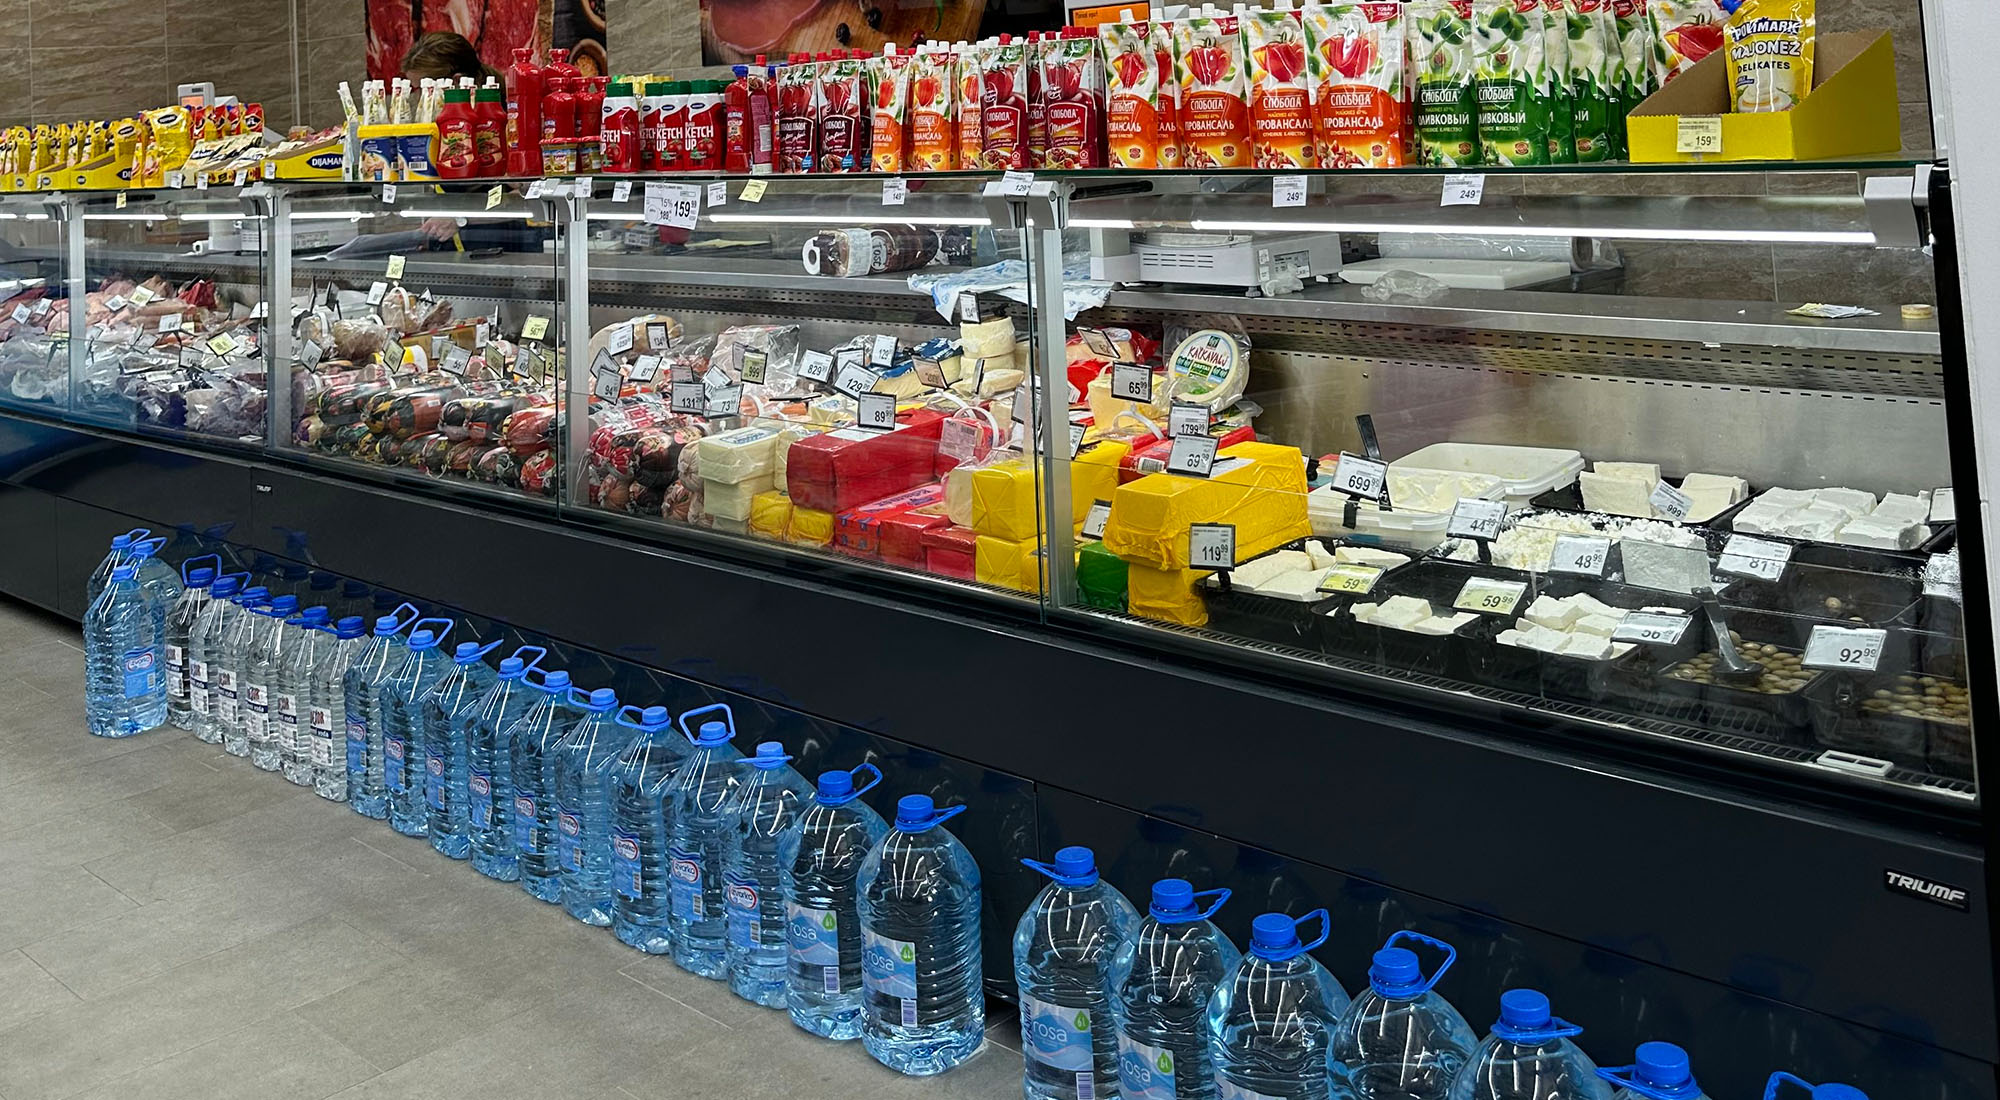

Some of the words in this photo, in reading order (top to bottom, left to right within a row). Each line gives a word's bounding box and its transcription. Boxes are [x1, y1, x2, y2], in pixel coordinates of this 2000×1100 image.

[1731, 41, 1801, 61] MAJONEZ
[1737, 61, 1791, 73] DELIKATES
[1190, 100, 1224, 110] СЛОБОДА
[1263, 97, 1302, 108] СЛОБОДА
[1331, 94, 1371, 106] СЛОБОДА
[1185, 119, 1235, 131] ПРОВАНСАЛЬ
[1256, 118, 1313, 130] ПРОВАНСАЛЬ
[1323, 116, 1384, 129] ПРОВАНСАЛЬ
[656, 126, 683, 140] KETCH
[685, 125, 714, 139] KETCH
[656, 139, 668, 152] UP
[685, 138, 698, 151] UP
[1695, 136, 1712, 146] 159
[1286, 191, 1300, 201] 249
[1460, 189, 1476, 199] 249
[674, 201, 691, 217] 159
[807, 364, 822, 376] 829
[846, 377, 863, 393] 129
[1128, 381, 1141, 395] 65
[682, 398, 696, 409] 131
[721, 400, 731, 412] 73
[874, 410, 886, 423] 89
[1181, 423, 1199, 434] 1799
[1348, 474, 1371, 492] 699
[1470, 519, 1486, 532] 44
[1202, 545, 1221, 561] 119
[1574, 555, 1593, 568] 48
[1342, 578, 1361, 590] 59
[1481, 594, 1502, 608] 59
[1839, 647, 1863, 664] 92
[1863, 647, 1877, 658] 99
[1886, 871, 1966, 901] TRIUMF
[790, 922, 817, 940] rosa
[867, 950, 895, 971] rosa
[1032, 1020, 1068, 1043] rosa
[1120, 1055, 1151, 1083] rosa
